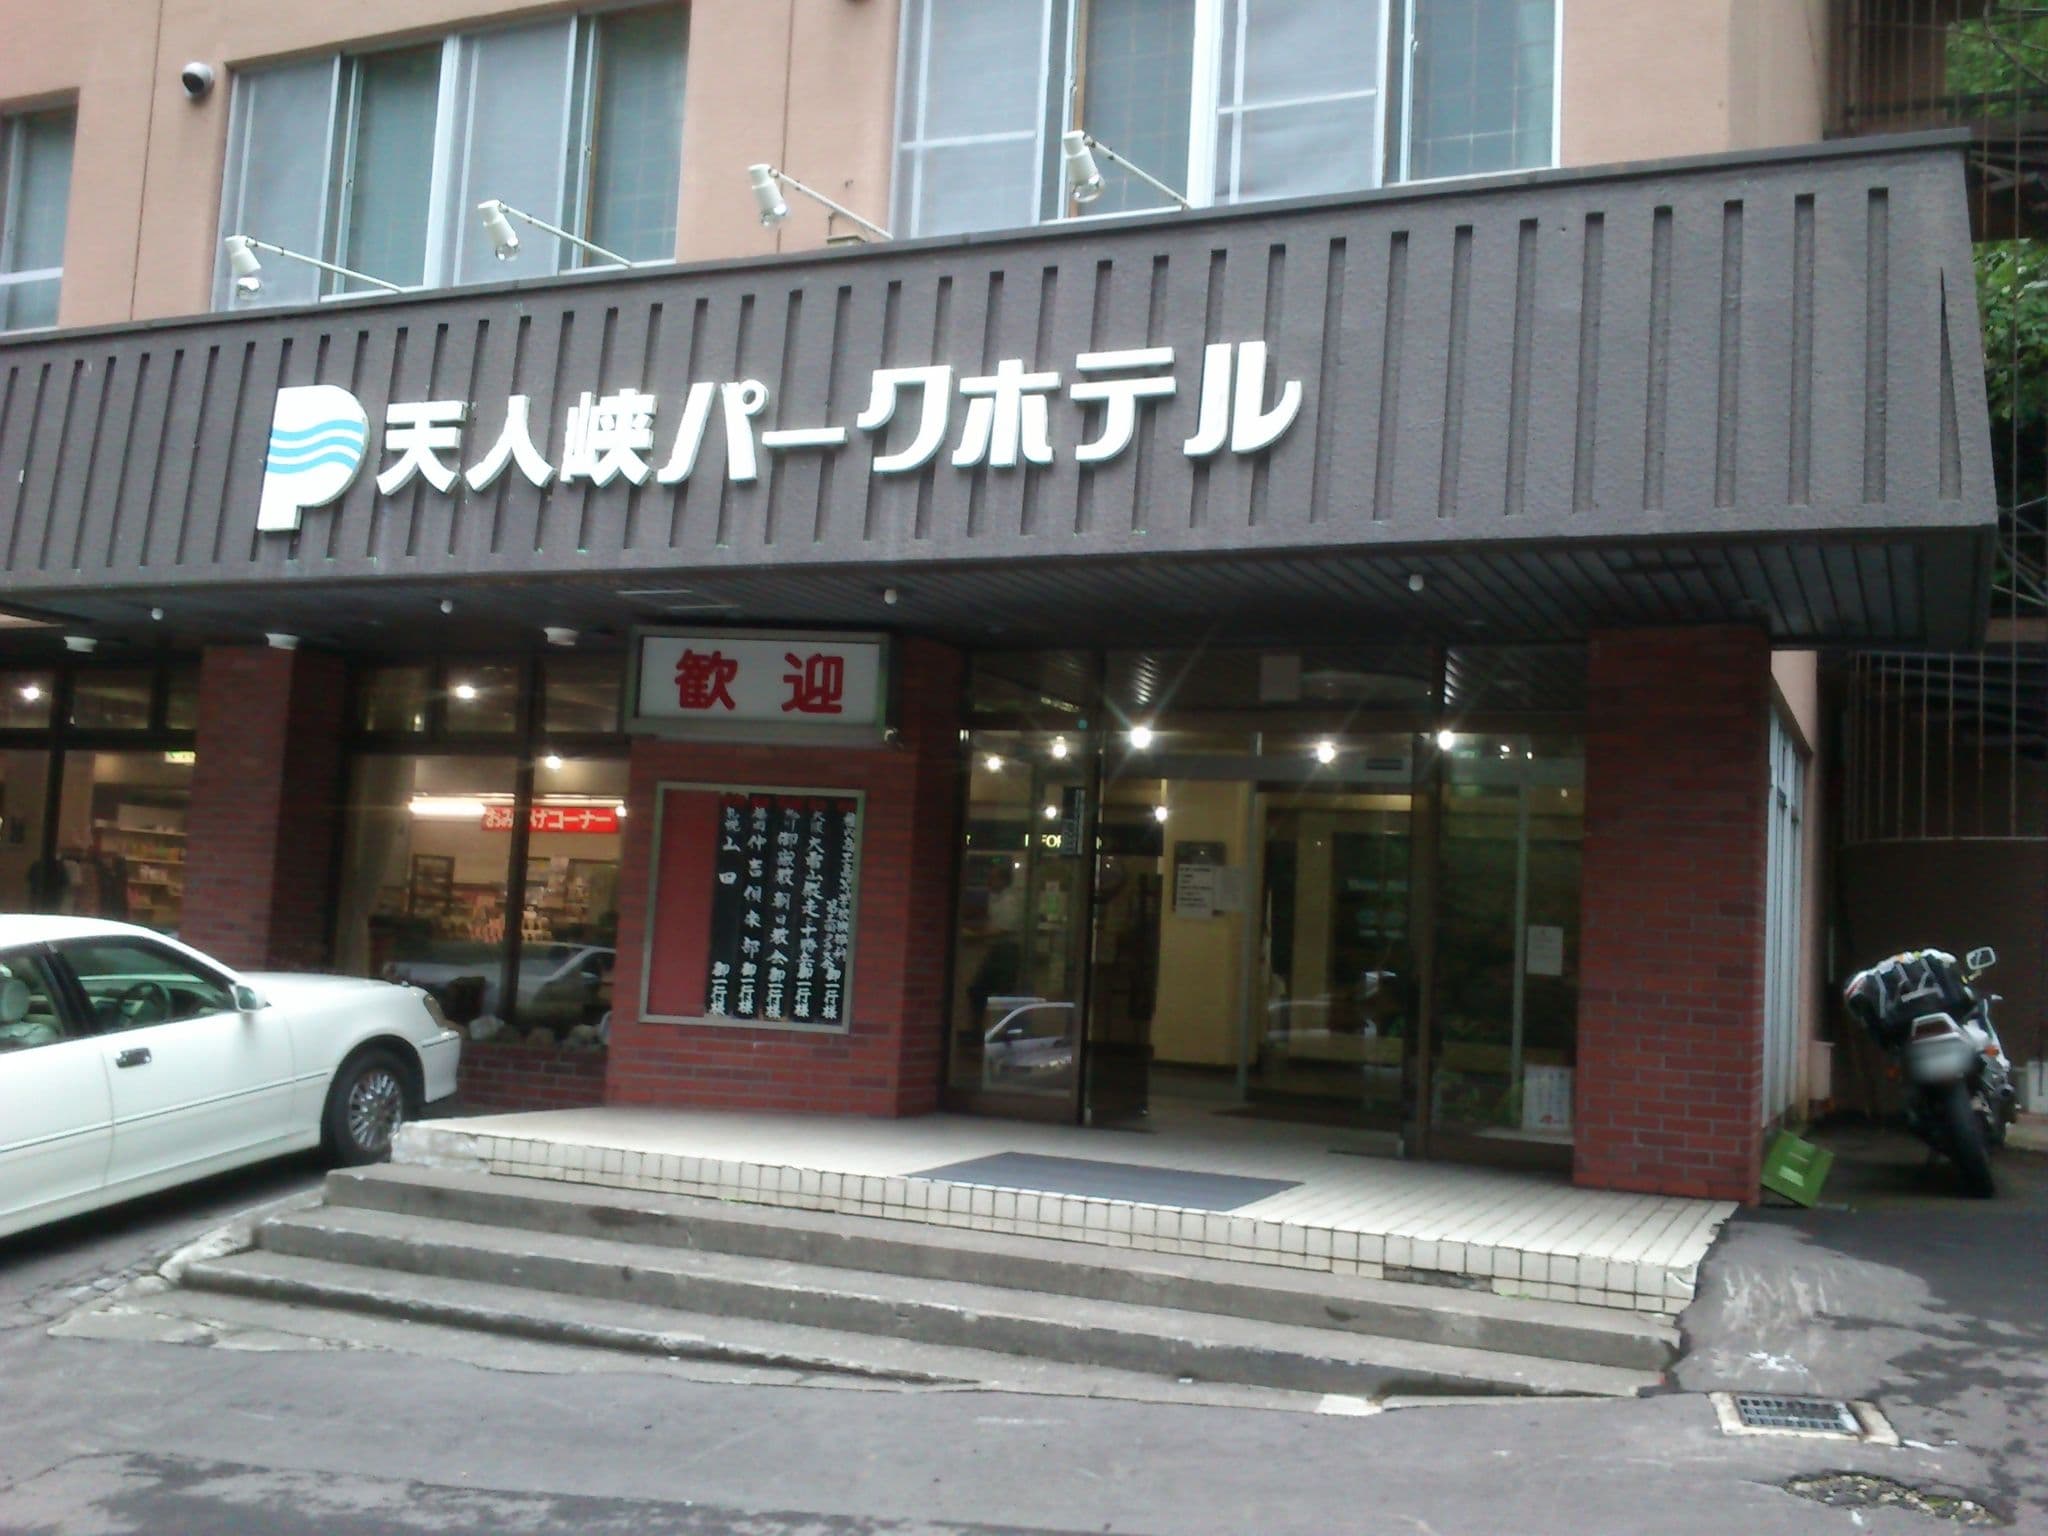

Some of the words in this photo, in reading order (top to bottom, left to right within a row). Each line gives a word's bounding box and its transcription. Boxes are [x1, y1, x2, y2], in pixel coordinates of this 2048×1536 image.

[374, 340, 1303, 498] 天人峡パークホテル
[673, 648, 844, 714] 歓迎
[485, 808, 612, 830] おみげコーナー
